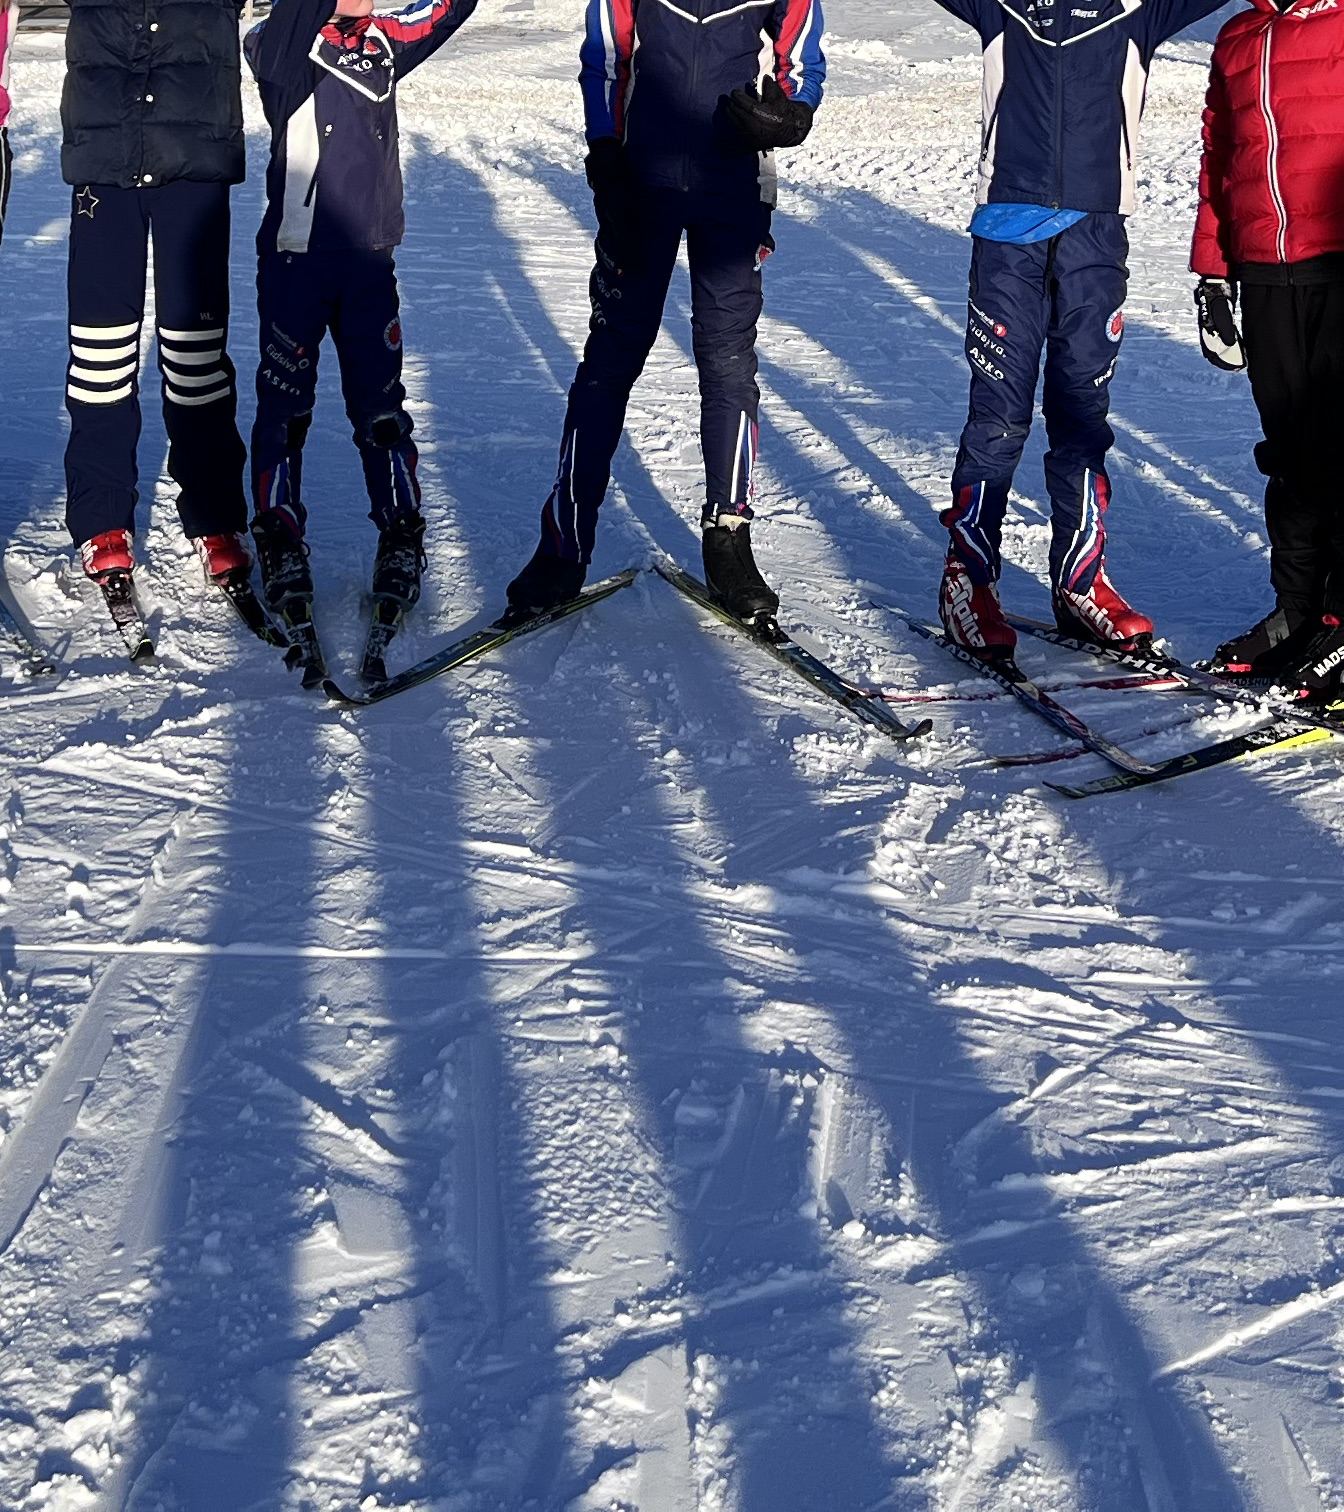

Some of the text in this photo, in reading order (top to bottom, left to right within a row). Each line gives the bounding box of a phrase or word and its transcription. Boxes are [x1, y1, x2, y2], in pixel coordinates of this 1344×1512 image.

[969, 347, 1004, 380] ASKO
[928, 632, 1023, 698] MADSHUS
[1031, 627, 1191, 687] MADSHUS
